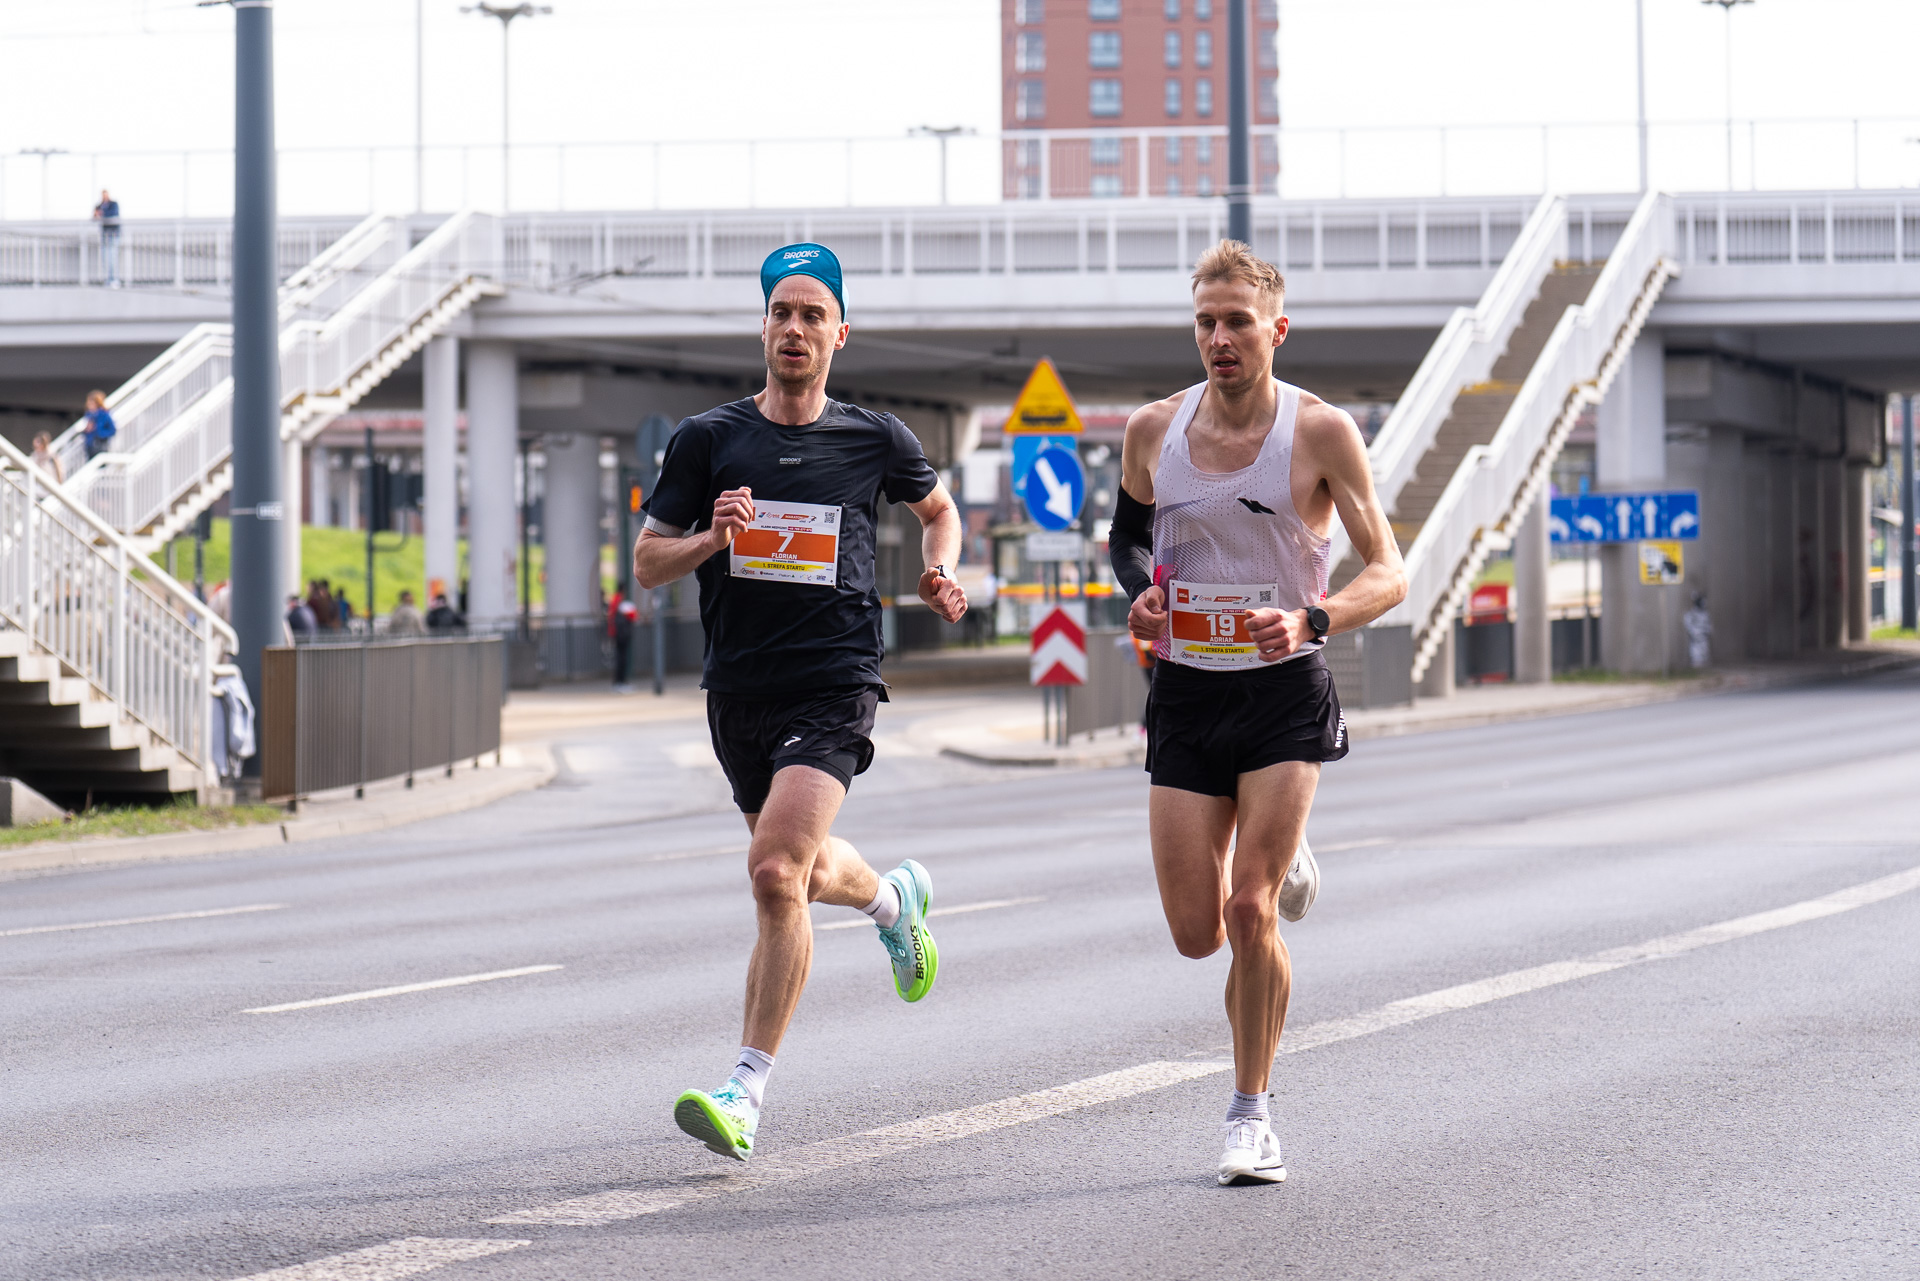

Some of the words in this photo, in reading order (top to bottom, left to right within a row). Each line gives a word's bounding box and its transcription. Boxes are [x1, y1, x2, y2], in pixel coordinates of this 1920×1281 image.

[783, 250, 820, 259] BROOKS
[777, 531, 795, 552] 7
[771, 552, 798, 560] FLORIAN
[1206, 614, 1236, 636] 19
[910, 925, 924, 980] BROOKS
